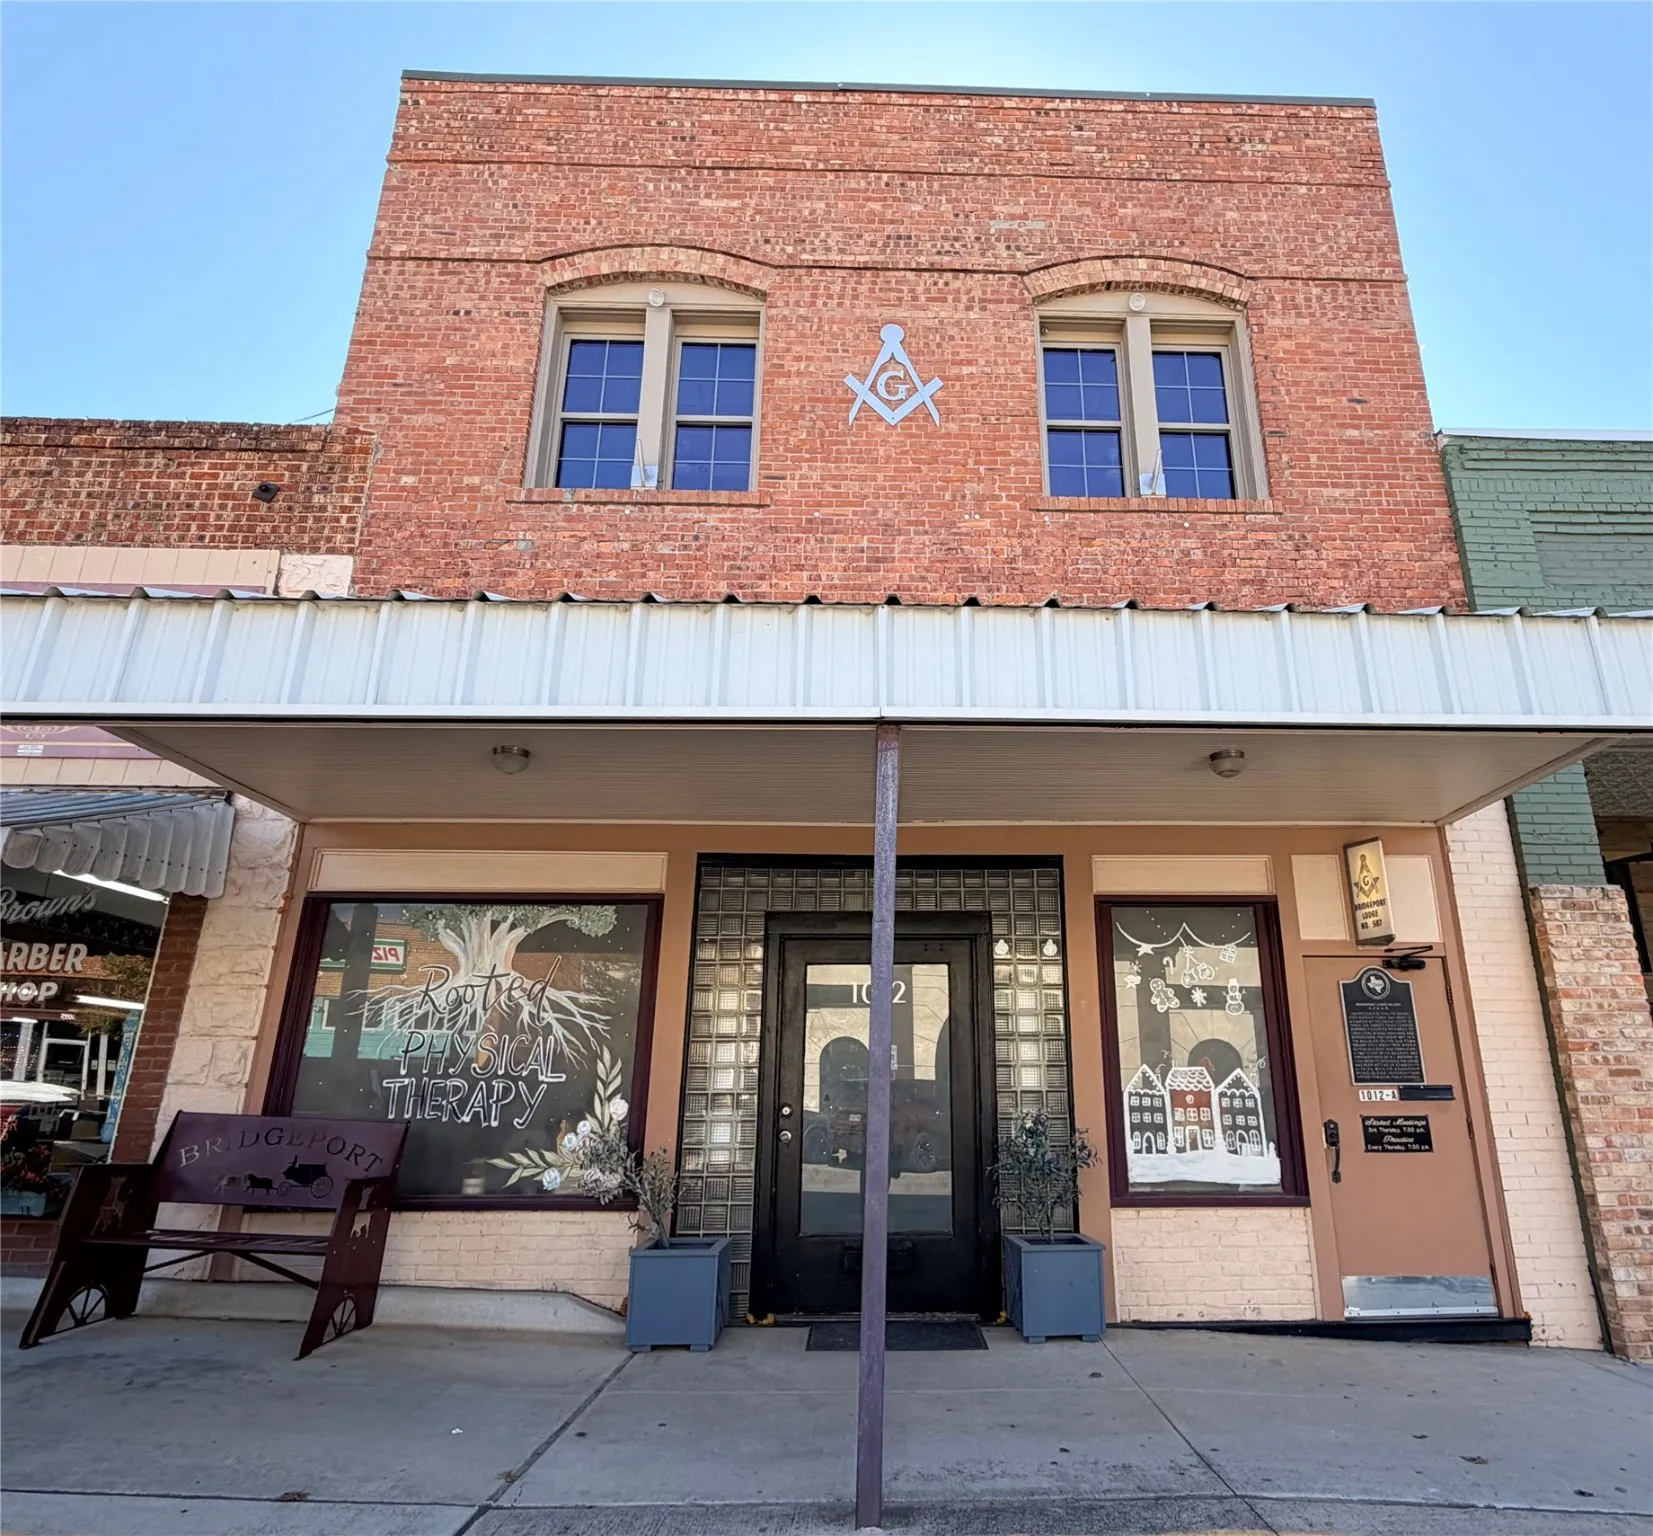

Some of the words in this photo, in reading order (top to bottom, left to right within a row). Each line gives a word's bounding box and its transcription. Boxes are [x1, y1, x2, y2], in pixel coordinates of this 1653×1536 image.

[877, 370, 910, 401] G
[1362, 875, 1370, 886] G
[1354, 898, 1386, 911] BRIDGEPORT
[1362, 910, 1379, 920] LODGE
[1372, 919, 1383, 929] 587
[418, 955, 562, 1026] Rooted
[852, 980, 907, 1004] 102
[400, 1030, 567, 1083] PHYSICAL
[1361, 1090, 1397, 1100] 1012-A
[382, 1077, 548, 1130] THERAPY
[1365, 1118, 1391, 1126] Stated
[1393, 1118, 1427, 1127] Meetings
[1383, 1135, 1415, 1143] Practice
